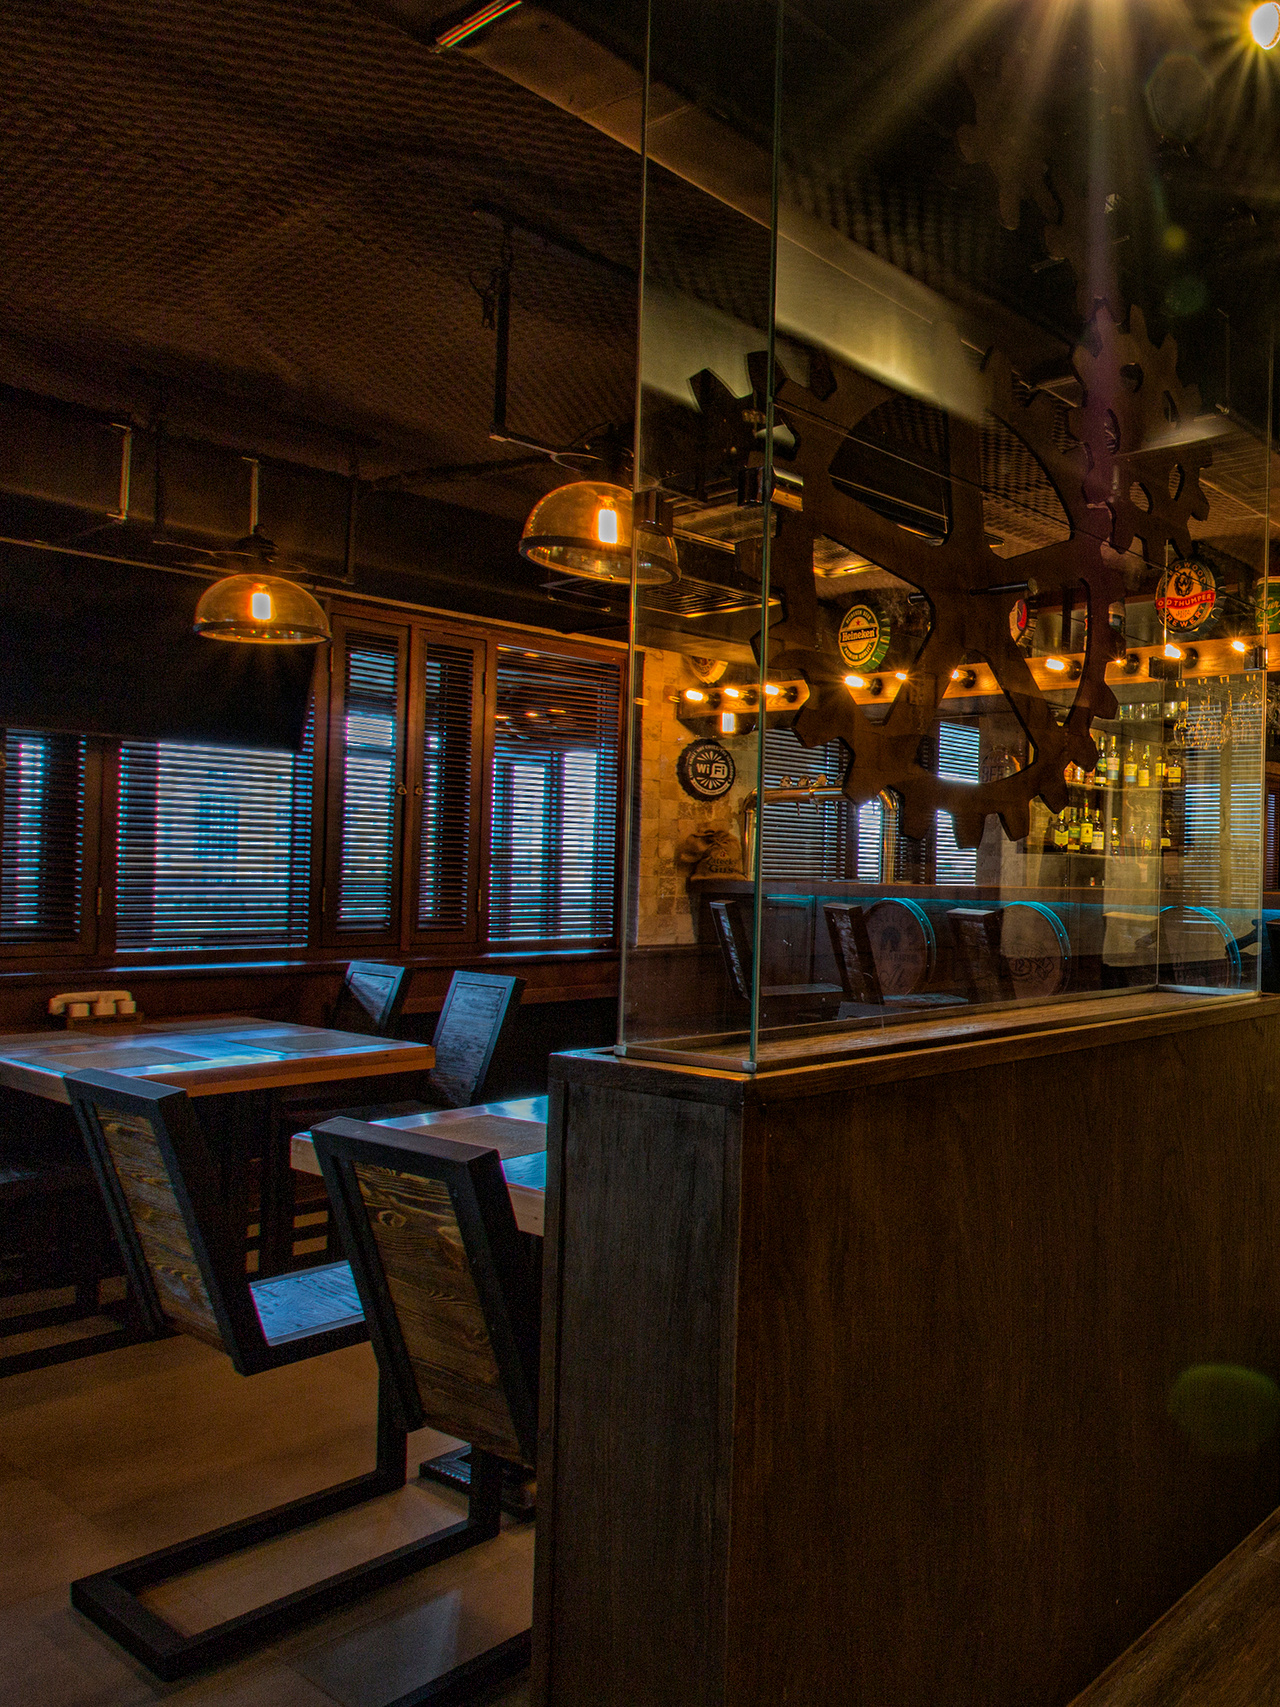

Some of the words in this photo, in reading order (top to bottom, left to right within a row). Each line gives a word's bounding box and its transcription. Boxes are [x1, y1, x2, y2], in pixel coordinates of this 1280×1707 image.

[1157, 599, 1173, 607] OD
[1173, 593, 1212, 608] THUMPER
[842, 627, 876, 642] Heineken
